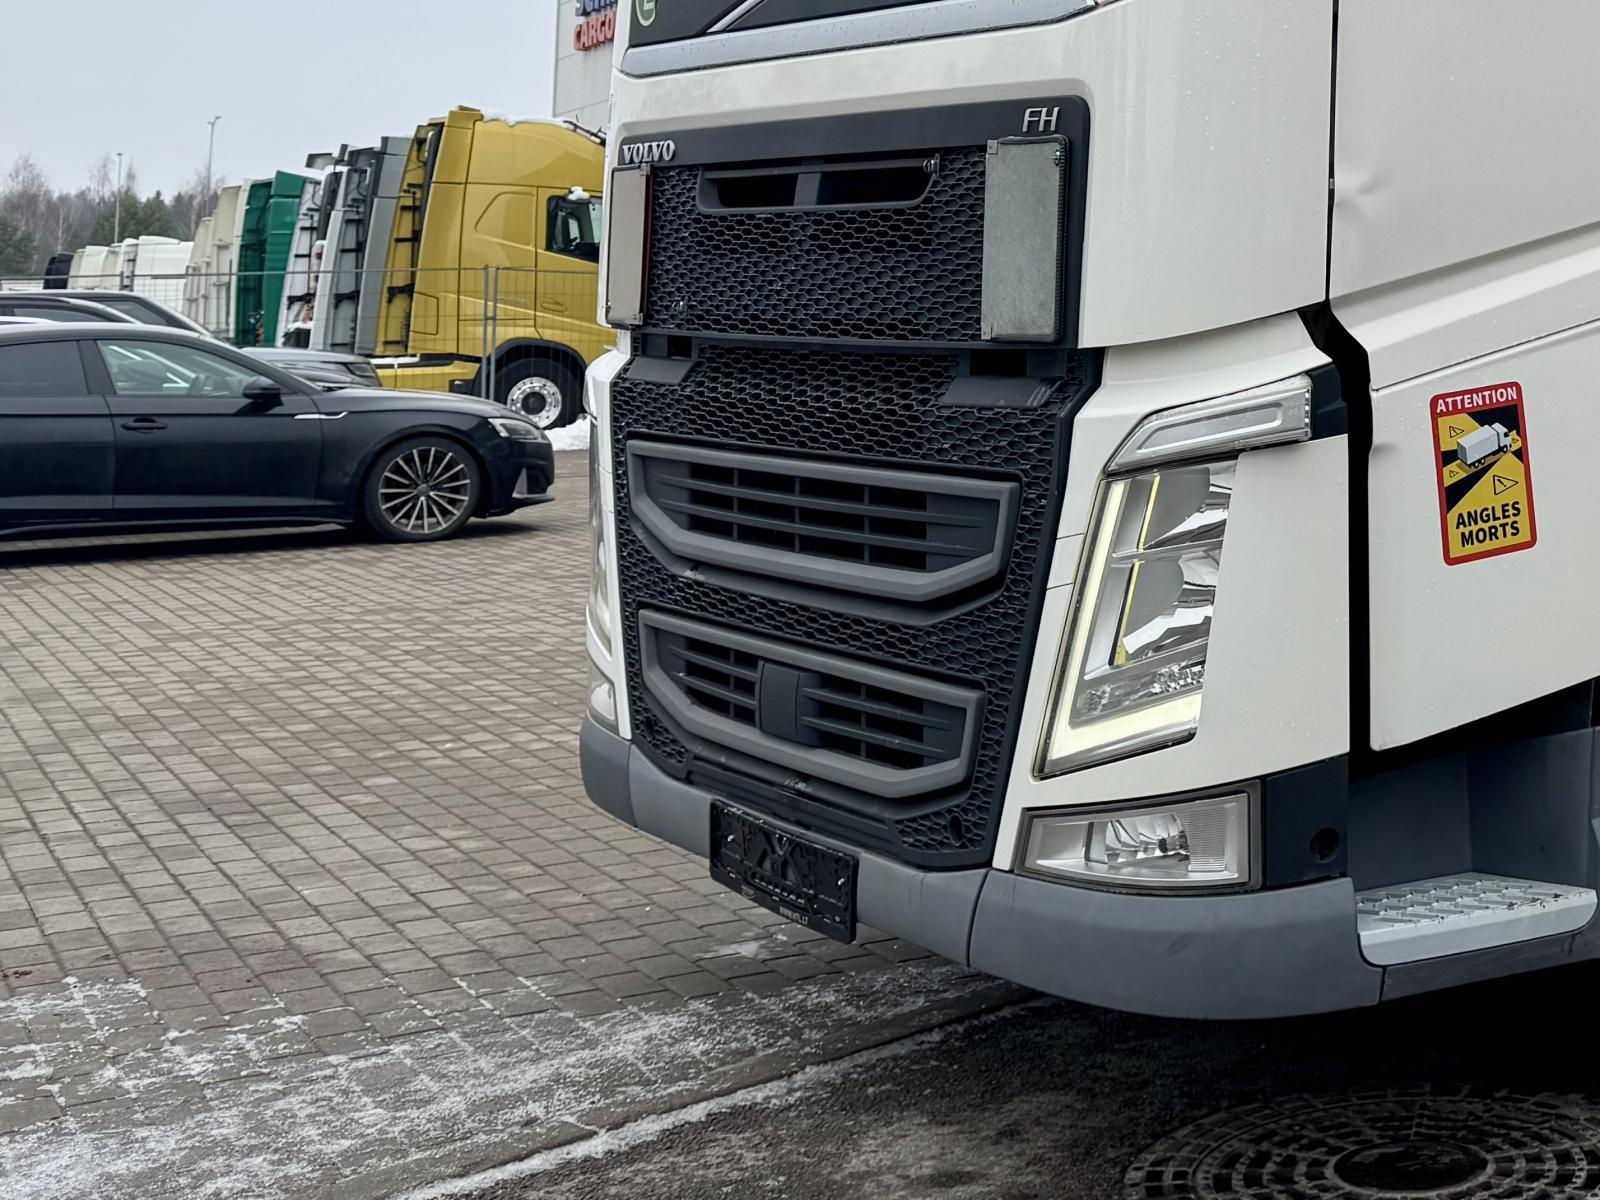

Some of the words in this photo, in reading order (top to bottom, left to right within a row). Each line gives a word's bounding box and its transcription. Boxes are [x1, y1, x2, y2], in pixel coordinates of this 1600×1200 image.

[574, 11, 616, 51] CARGO
[1022, 106, 1061, 132] FH
[622, 139, 676, 164] VOLVO
[1436, 386, 1518, 414] ATTENTION
[1455, 500, 1521, 530] ANGLES
[1461, 520, 1521, 548] MORTS
